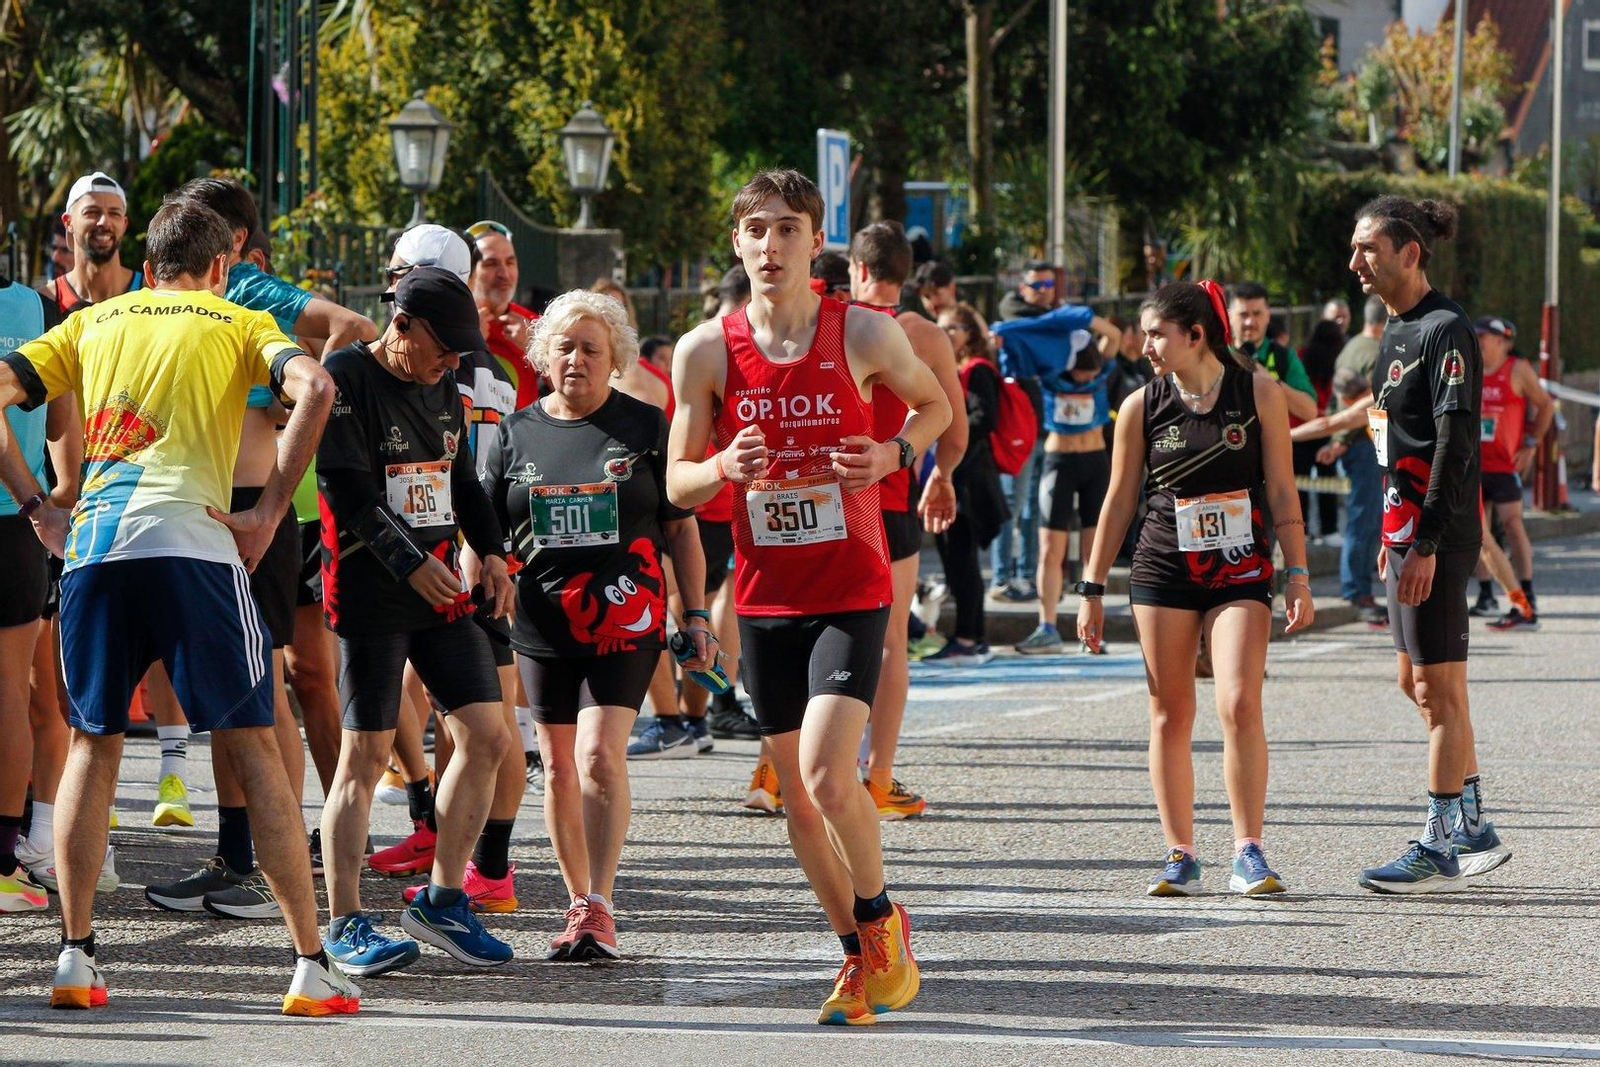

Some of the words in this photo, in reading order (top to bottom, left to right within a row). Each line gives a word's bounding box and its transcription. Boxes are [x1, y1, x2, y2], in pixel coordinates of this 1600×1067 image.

[829, 143, 846, 236] P
[96, 308, 124, 323] C.A.
[129, 304, 232, 324] CAMBADOS
[387, 441, 410, 453] Trigal
[1162, 439, 1187, 451] Trigal
[408, 483, 436, 514] 136
[568, 496, 593, 504] CARMEN
[550, 504, 591, 535] 501
[764, 499, 819, 532] 350
[1198, 511, 1227, 538] 131
